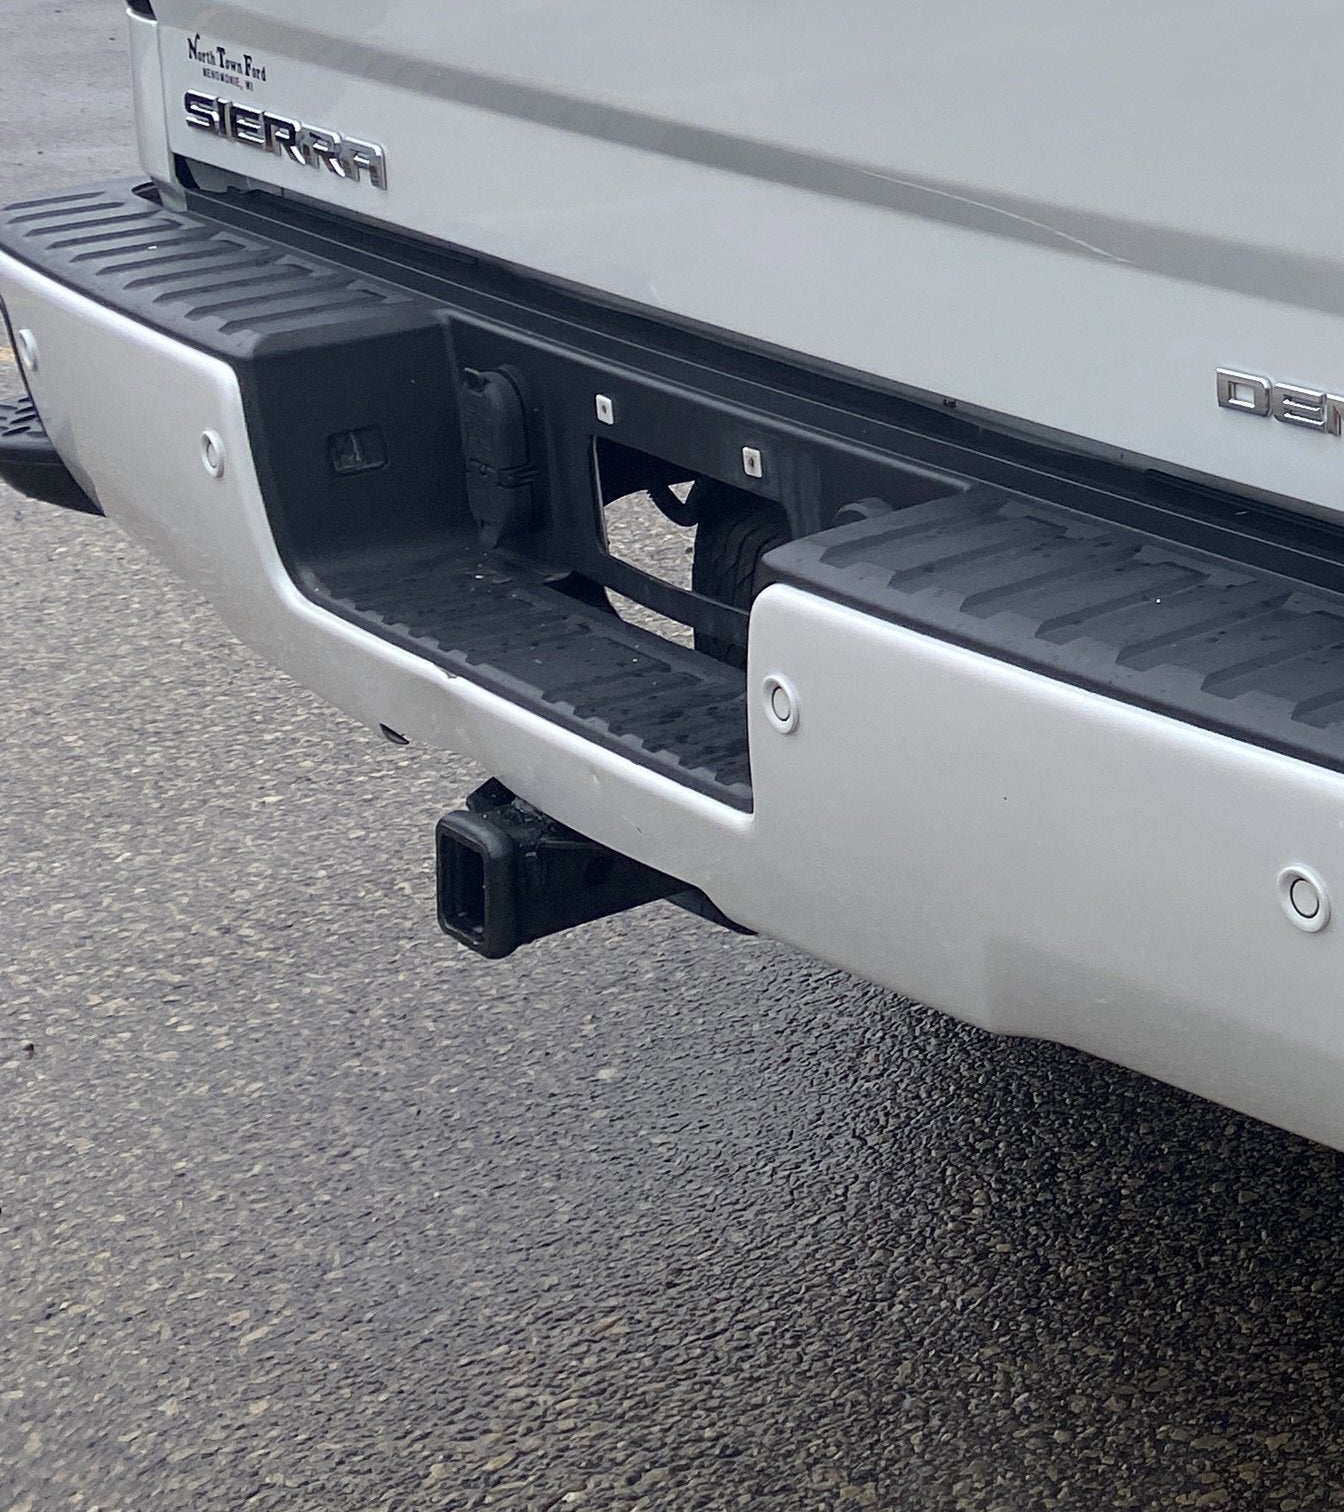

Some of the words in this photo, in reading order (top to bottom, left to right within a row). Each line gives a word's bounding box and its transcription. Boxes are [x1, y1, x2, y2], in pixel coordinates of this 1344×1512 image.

[187, 33, 217, 66] North
[216, 46, 243, 74] Town
[243, 54, 266, 82] Ford
[184, 89, 388, 190] SIERRA
